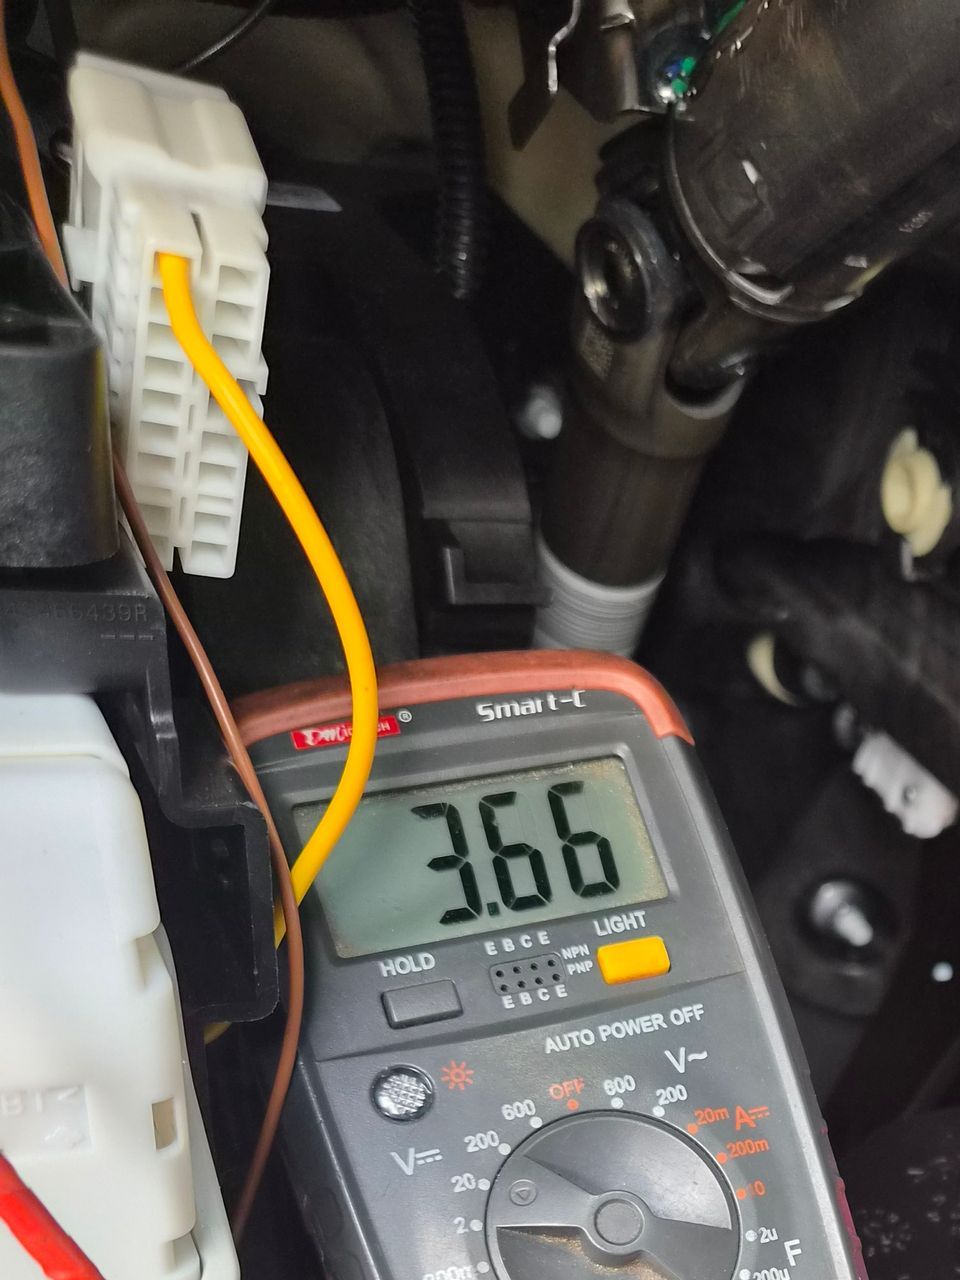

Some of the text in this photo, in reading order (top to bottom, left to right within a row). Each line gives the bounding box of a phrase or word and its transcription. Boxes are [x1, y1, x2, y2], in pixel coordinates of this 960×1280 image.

[410, 780, 622, 926] 3.66
[594, 911, 647, 938] LIGHT
[484, 930, 551, 956] E B C E
[561, 944, 590, 960] NPN
[379, 953, 436, 978] HOLD
[567, 960, 594, 975] PNP
[503, 984, 568, 1010] E B C E
[544, 1003, 705, 1054] AUTO POWER OFF
[549, 1078, 586, 1100] OFF
[603, 1074, 636, 1095] 600
[655, 1084, 688, 1106] 200
[501, 1099, 537, 1121] 600
[693, 1106, 730, 1127] 20m
[464, 1130, 500, 1153] 200
[725, 1137, 770, 1160] 200m
[451, 1173, 476, 1193] 20
[454, 1217, 469, 1234] 2
[757, 1227, 778, 1244] 2u
[784, 1239, 803, 1267] F
